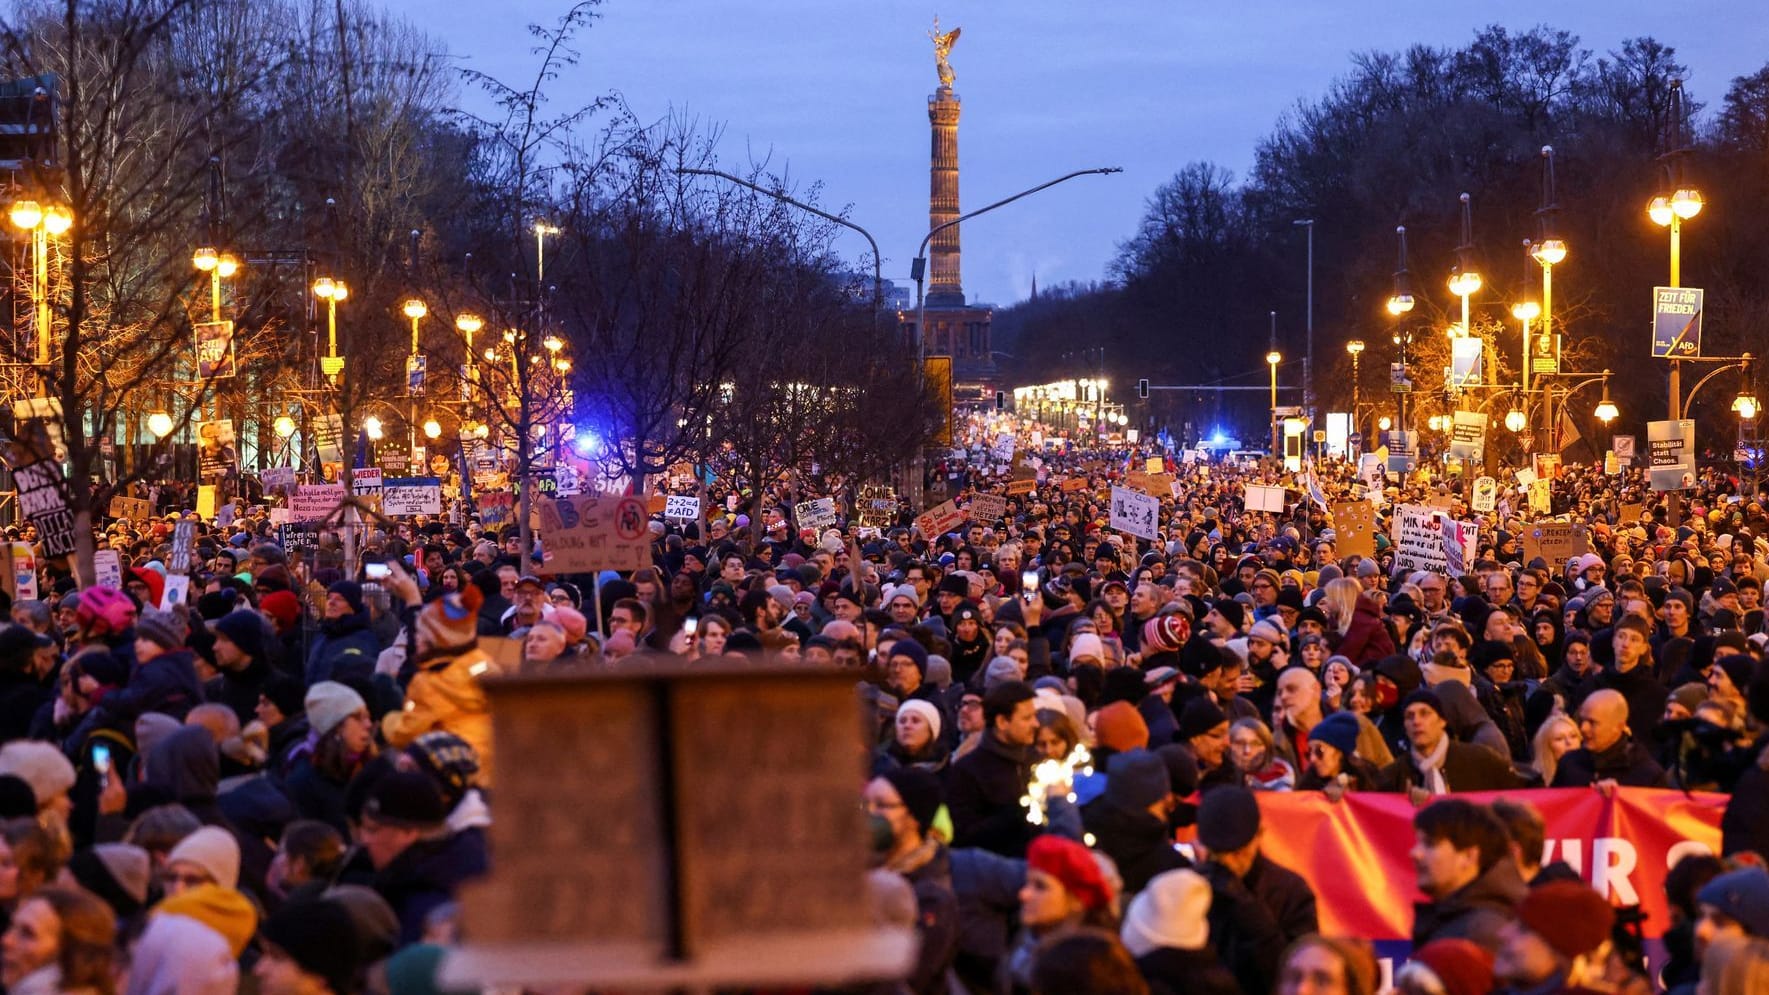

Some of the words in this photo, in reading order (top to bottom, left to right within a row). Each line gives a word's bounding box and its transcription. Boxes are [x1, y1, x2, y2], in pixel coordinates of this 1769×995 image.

[1659, 292, 1678, 302] ZEIT
[1679, 290, 1696, 303] FÜR
[1658, 303, 1696, 314] FRIEDEN.
[1679, 341, 1694, 350] AfD
[1652, 441, 1682, 449] Stabilität
[353, 469, 380, 479] WIEDER
[865, 487, 891, 499] OHNE
[667, 498, 698, 507] 2+2=4
[542, 499, 599, 533] ABC
[674, 507, 694, 516] AfD
[1403, 516, 1418, 529] MIR
[1397, 556, 1415, 568] WIRD
